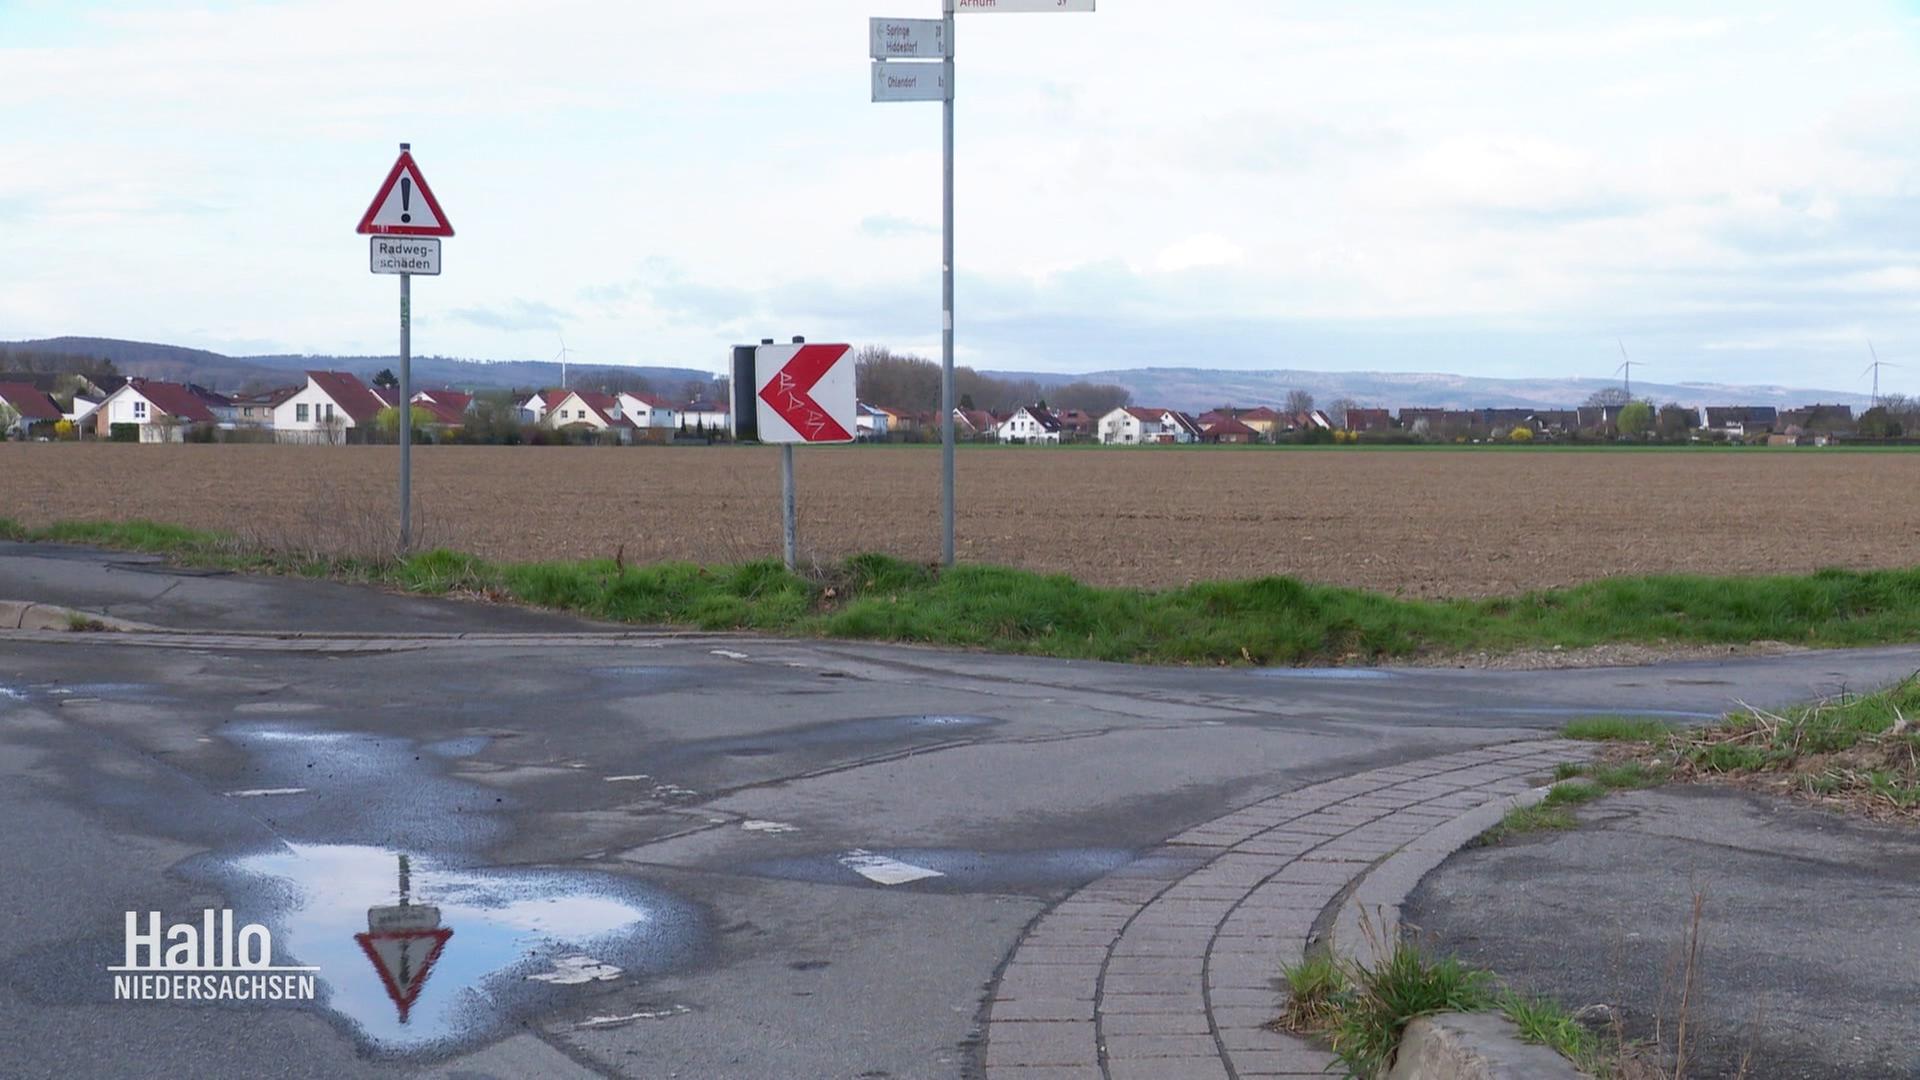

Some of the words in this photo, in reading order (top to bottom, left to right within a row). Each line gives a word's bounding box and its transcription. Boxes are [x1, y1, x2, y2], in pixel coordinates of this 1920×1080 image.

[886, 24, 910, 39] Springe
[886, 41, 918, 54] Hiddestorf
[887, 76, 917, 89] Ohlendorf
[379, 243, 433, 257] Radweg-
[379, 258, 430, 270] schäden
